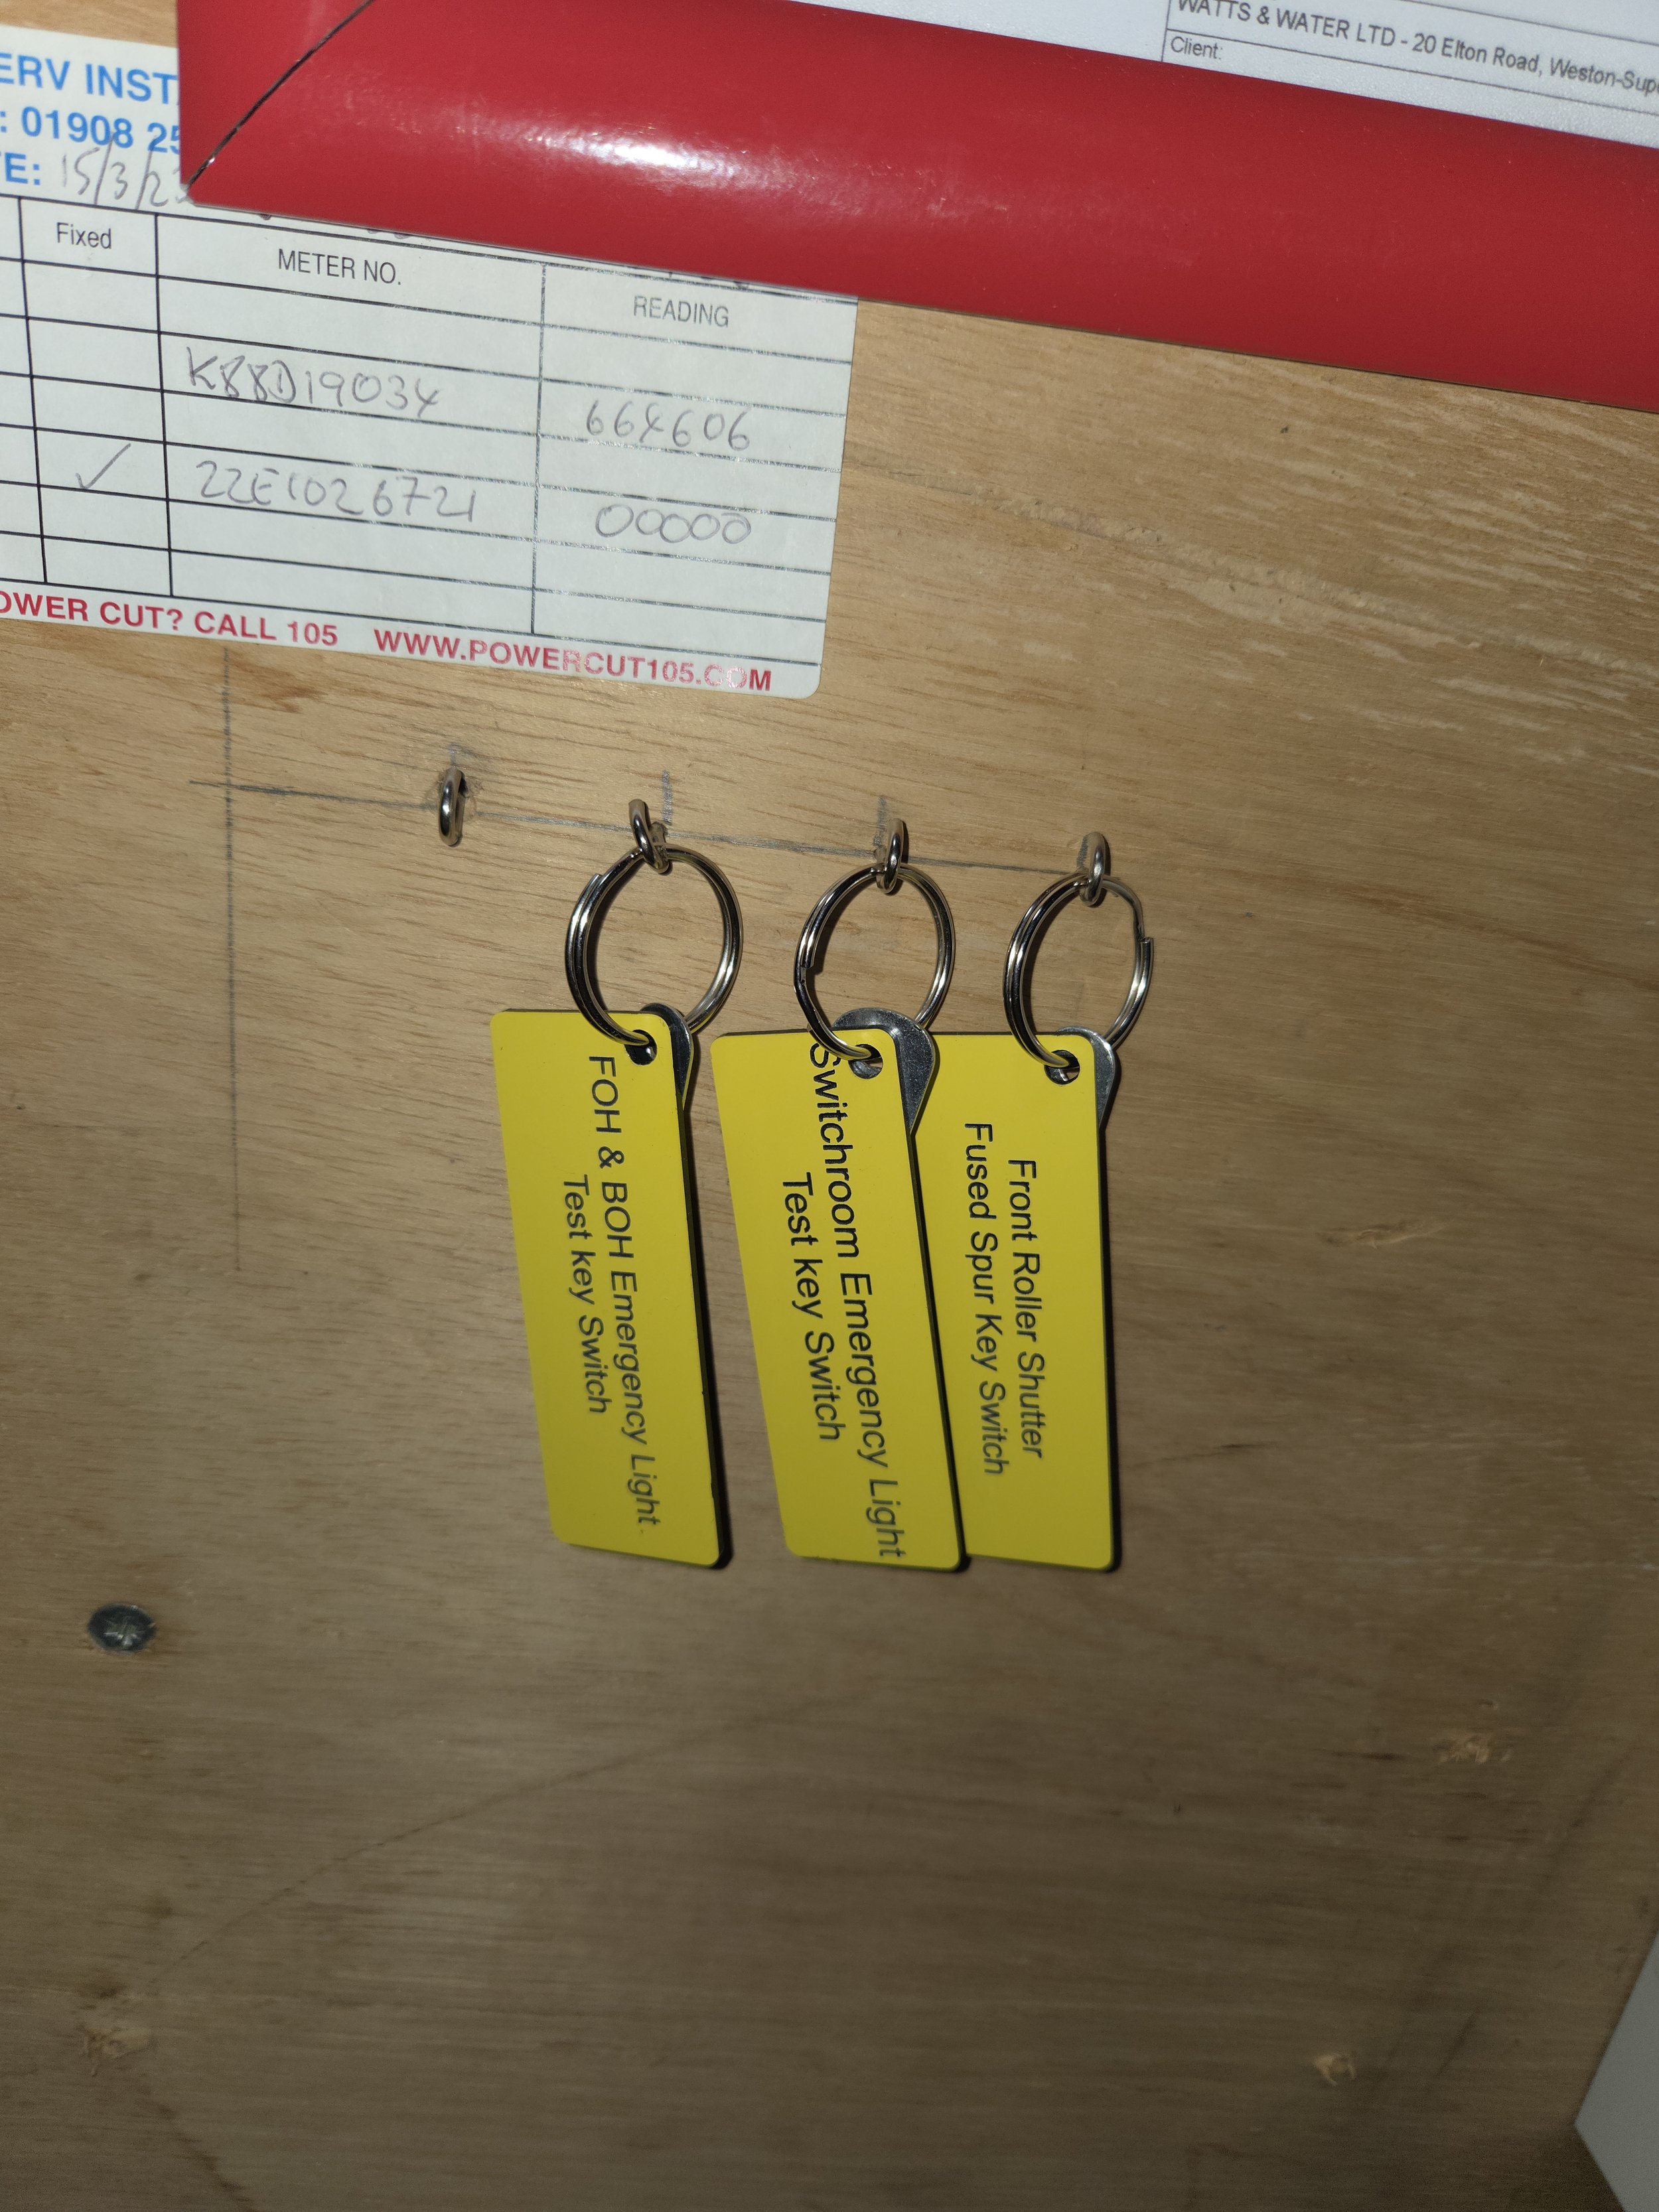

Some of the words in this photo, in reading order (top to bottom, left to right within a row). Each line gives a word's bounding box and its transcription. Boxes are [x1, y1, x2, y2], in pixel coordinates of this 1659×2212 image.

[85, 63, 180, 106] INST
[1170, 36, 1224, 60] Client:
[1257, 5, 1270, 25] &
[1275, 7, 1350, 40] WATER
[1356, 22, 1396, 48] LTD
[1412, 33, 1437, 54] 20
[1441, 37, 1488, 64] Elton
[1493, 46, 1544, 78] Road,
[1549, 58, 1659, 98] Weston-Sup
[21, 106, 134, 149] 01908
[0, 151, 41, 186] E:
[61, 131, 189, 211] 15/3/2
[56, 222, 111, 249] Fixed
[278, 248, 355, 280] METER
[364, 259, 401, 285] NO.
[632, 294, 729, 327] READING
[100, 600, 183, 631] CUT?
[194, 611, 277, 640] CALL
[287, 621, 338, 646] 105
[374, 628, 772, 692] WWW.POWERCUT105.COM
[589, 1055, 622, 1134] FOH
[598, 1145, 625, 1169] &
[964, 1123, 997, 1220] Fused
[601, 1181, 634, 1259] BOH
[1007, 1159, 1038, 1242] Front
[563, 1174, 593, 1240] Test
[578, 1314, 613, 1414] Switch
[782, 1171, 819, 1246] Test
[804, 1331, 846, 1441] Switch
[810, 1043, 860, 1258] Switchroom
[839, 1272, 889, 1468] Emergency
[866, 1478, 906, 1558] Light
[965, 1231, 998, 1305] Spur
[1012, 1252, 1043, 1343] Roller
[611, 1270, 648, 1445] Emergency
[970, 1313, 1003, 1372] Key
[978, 1380, 1010, 1475] Switch
[1017, 1351, 1046, 1459] Shutter
[627, 1453, 660, 1526] Light
